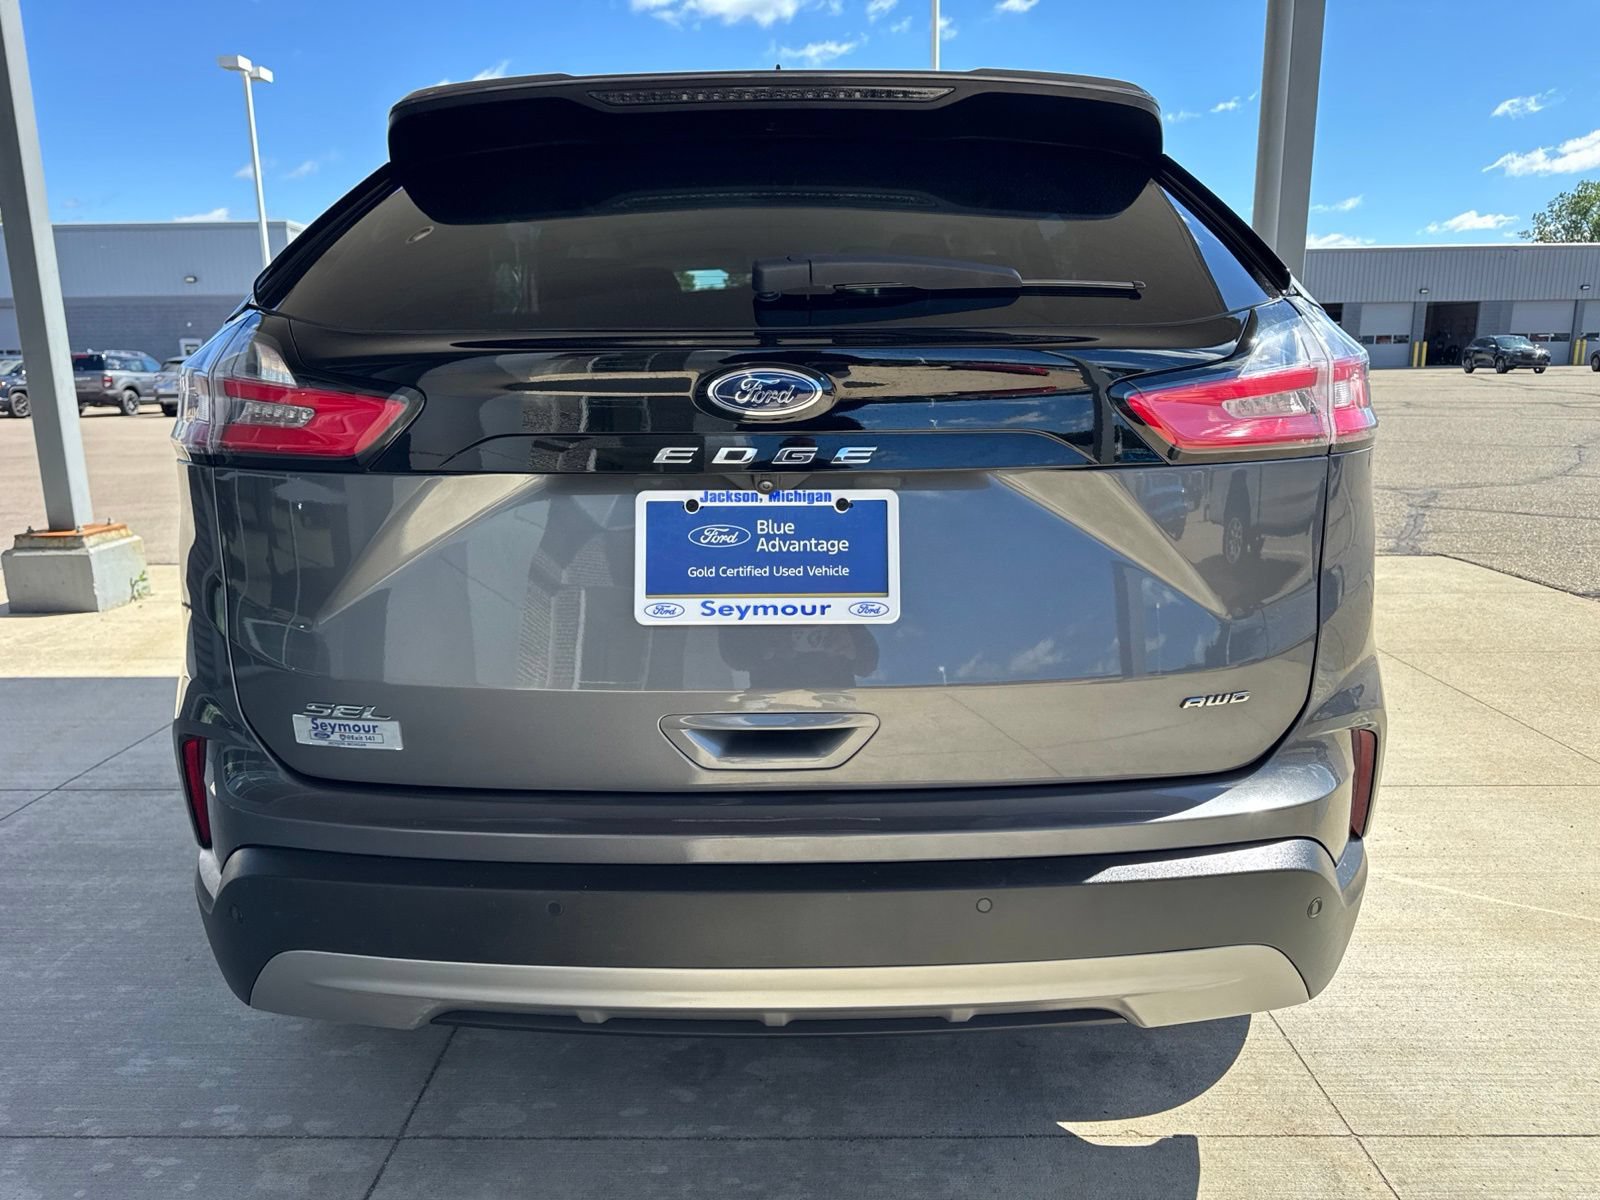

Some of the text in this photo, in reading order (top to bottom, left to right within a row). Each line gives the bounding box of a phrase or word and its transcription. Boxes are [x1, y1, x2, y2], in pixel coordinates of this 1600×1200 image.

[734, 377, 795, 405] Ford
[652, 446, 878, 464] EDGE
[700, 490, 832, 504] Jackson, Michigan
[700, 527, 739, 544] Ford
[757, 520, 795, 534] Blue
[756, 537, 849, 555] Advantage
[687, 565, 850, 577] Gold Certified Used Vehicle
[652, 600, 881, 620] Ford Seymour Ford
[1180, 690, 1251, 708] AWD
[303, 703, 392, 720] SEL
[311, 718, 378, 735] Seymour
